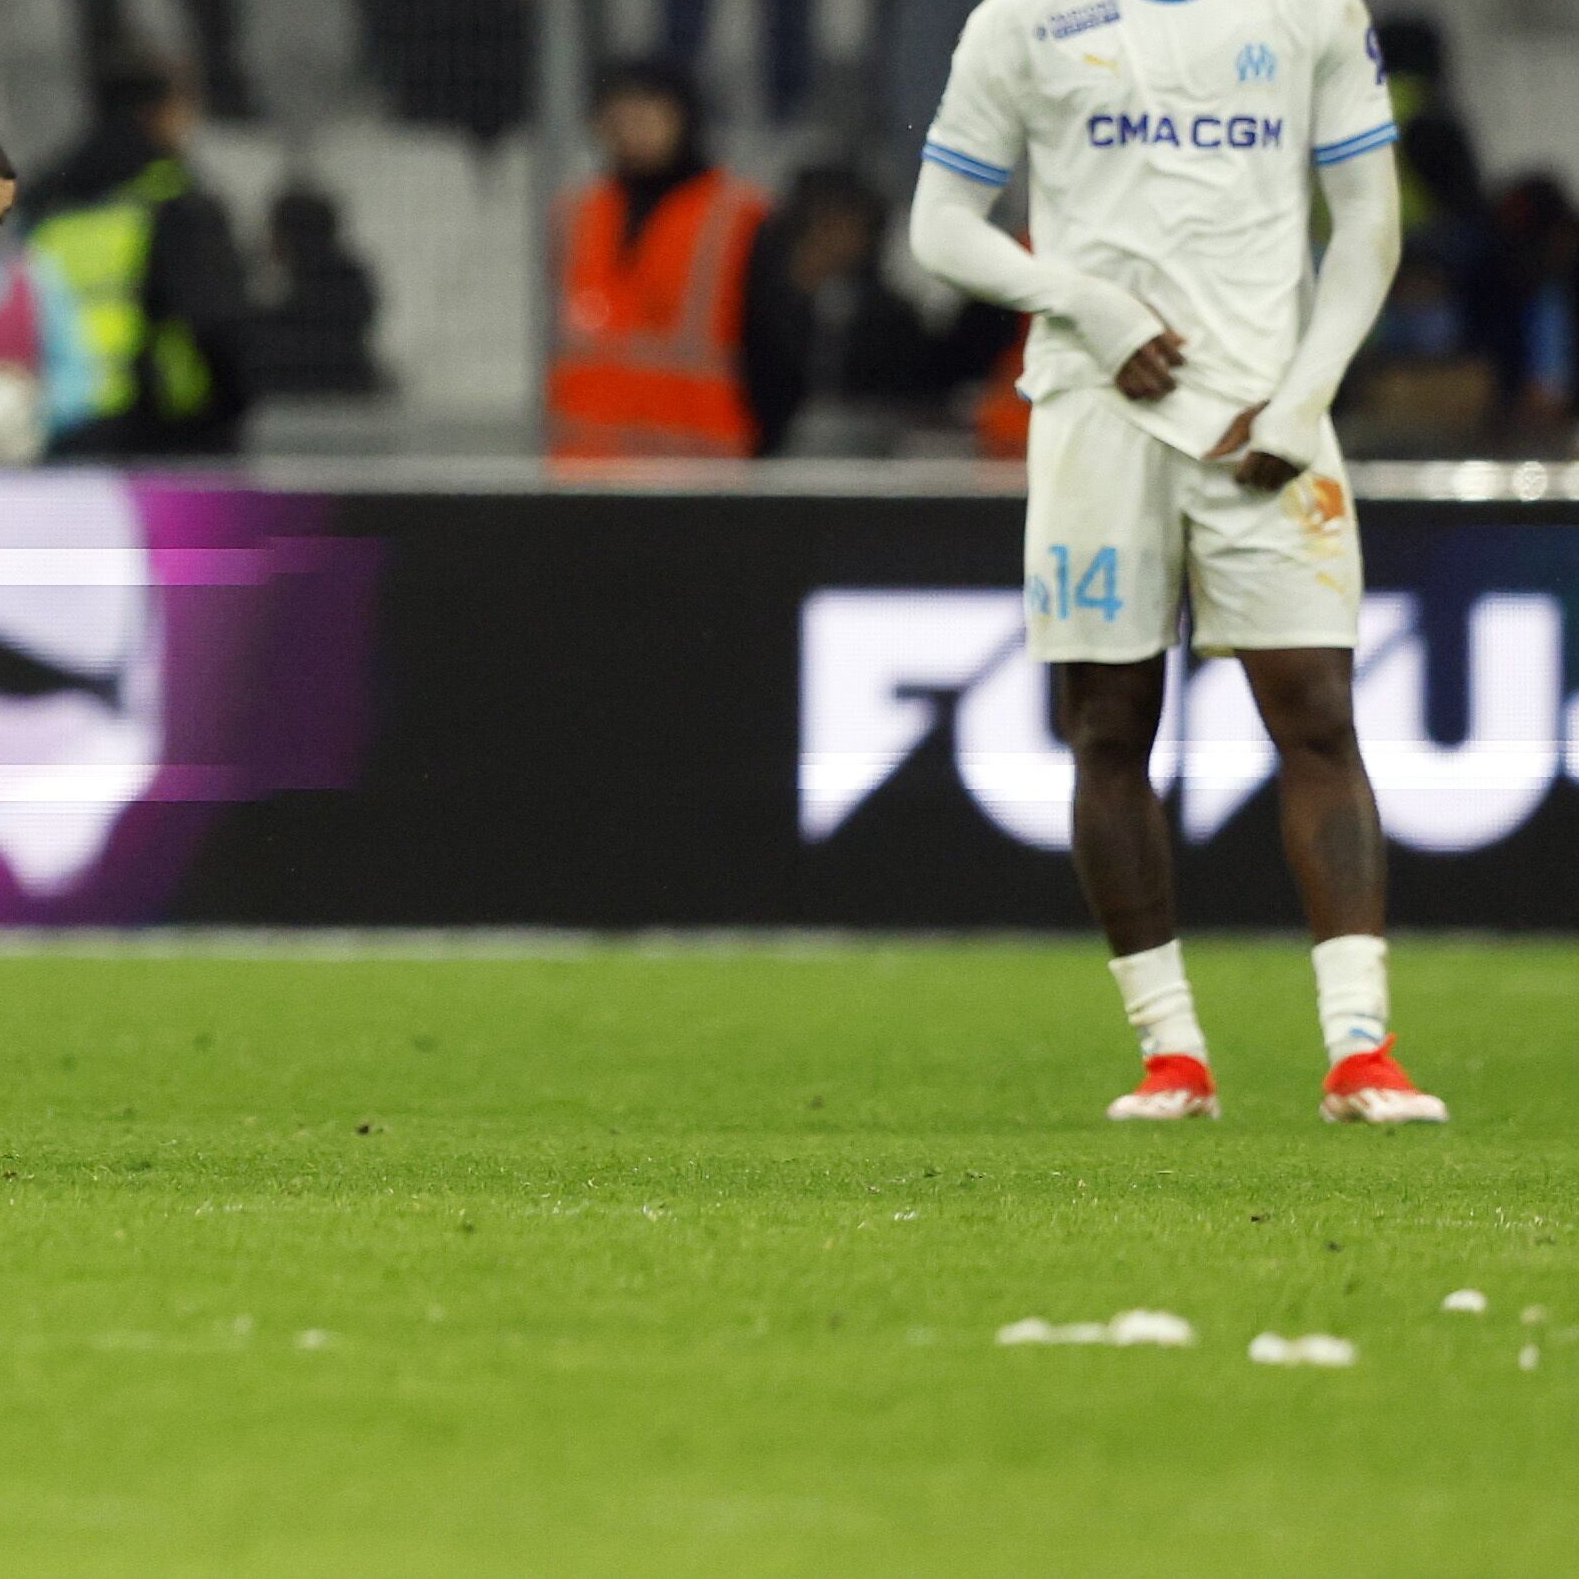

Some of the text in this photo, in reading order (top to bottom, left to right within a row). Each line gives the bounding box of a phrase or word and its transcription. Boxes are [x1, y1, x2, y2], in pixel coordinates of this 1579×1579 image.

[1086, 115, 1283, 149] CMA CGM
[1047, 544, 1123, 622] 14
